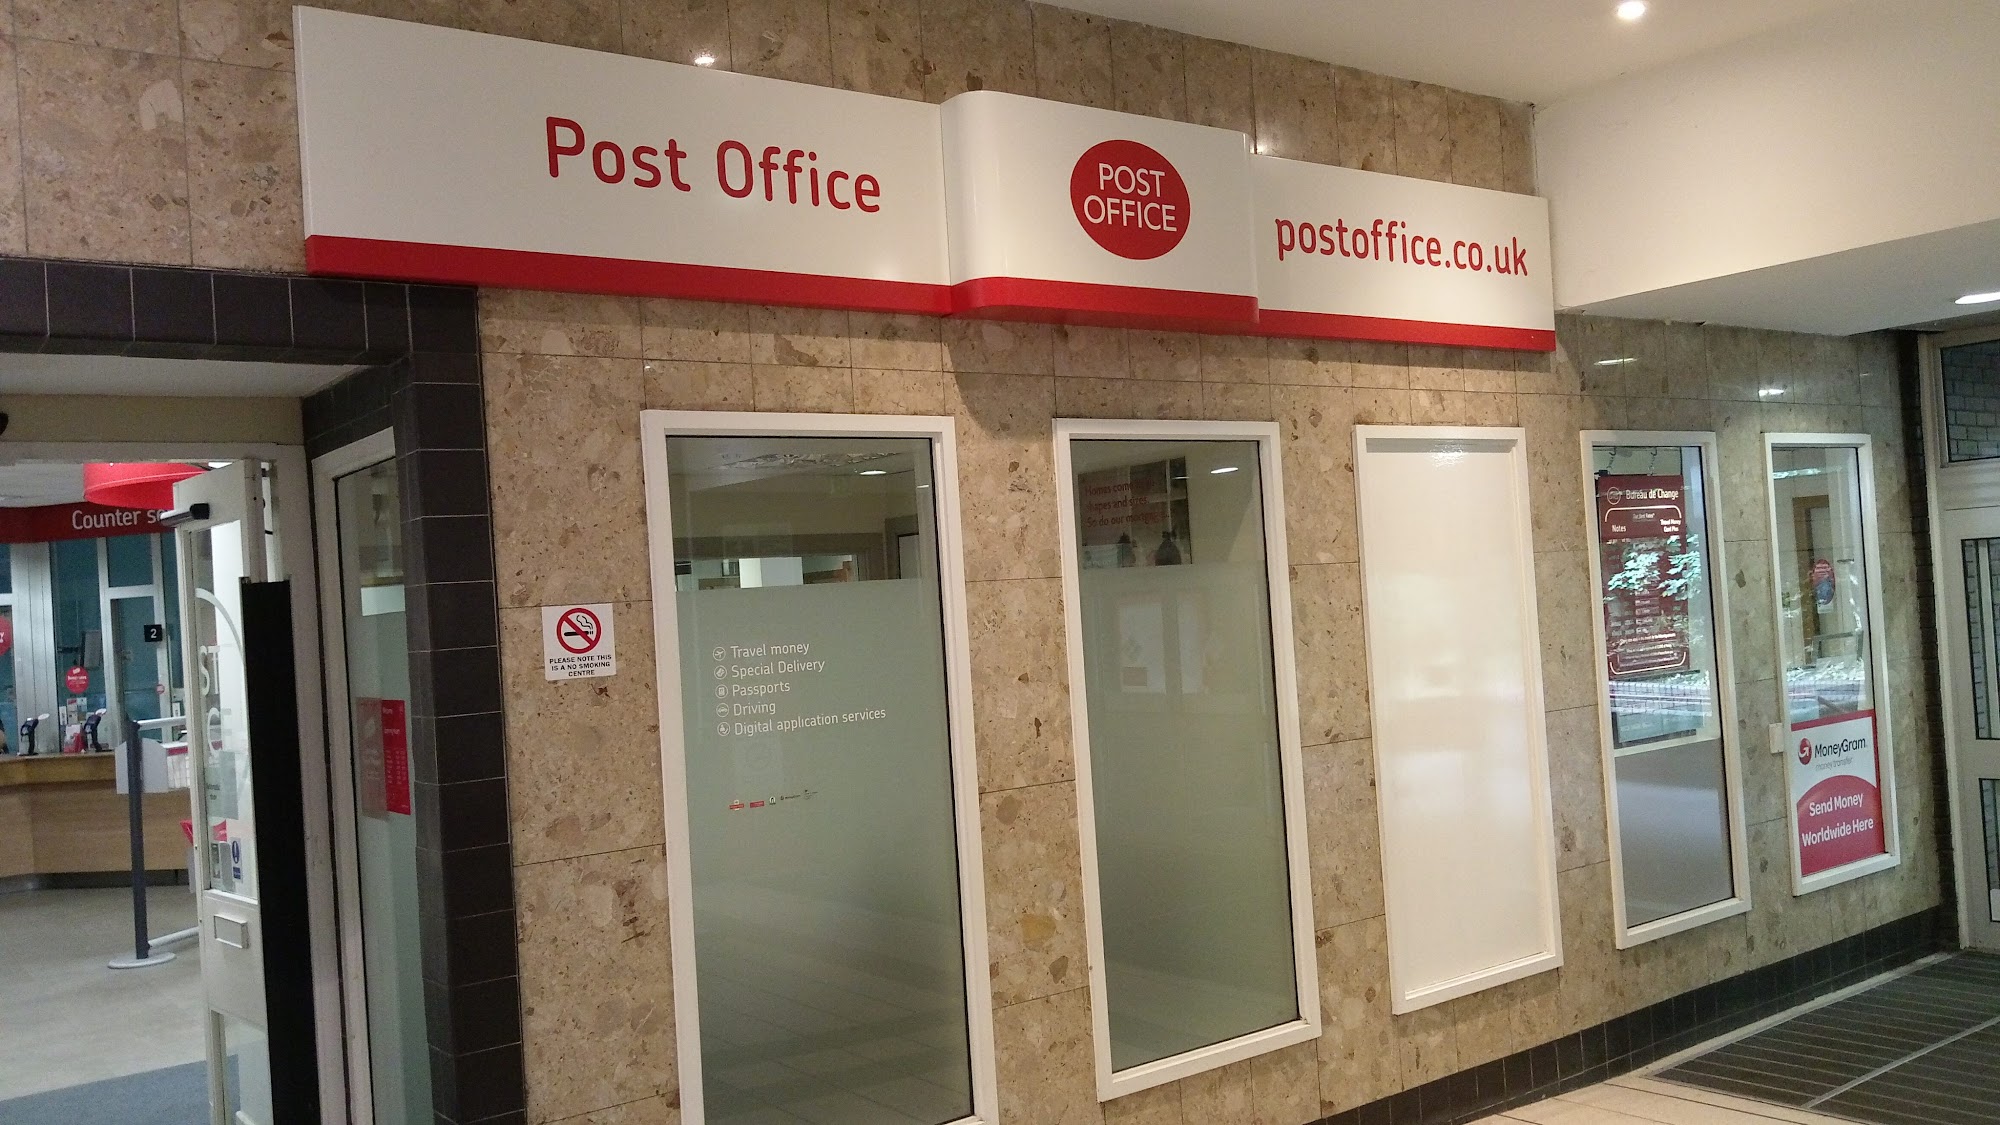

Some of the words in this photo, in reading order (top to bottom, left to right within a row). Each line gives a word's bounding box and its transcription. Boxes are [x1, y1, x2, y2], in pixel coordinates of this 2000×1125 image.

[545, 116, 691, 192] Post
[716, 140, 881, 213] Office
[1098, 162, 1166, 198] POST
[1083, 194, 1178, 232] OFFICE
[1275, 217, 1529, 277] postoffice.co.uk
[1112, 495, 1128, 508] and
[1625, 489, 1647, 500] Bureau
[1648, 488, 1657, 499] de
[1657, 488, 1680, 501] Change
[72, 509, 141, 530] Counter
[1611, 525, 1627, 533] Notes
[150, 628, 157, 639] 2
[549, 656, 576, 664] PLEASE
[730, 644, 767, 660] Travel
[770, 643, 810, 656] money
[568, 669, 596, 677] CENTRE
[579, 661, 611, 669] SMOKING
[731, 662, 774, 680] Special
[778, 659, 826, 674] Delivery
[732, 681, 791, 697] Passports
[733, 702, 776, 717] Driving
[734, 720, 773, 737] Digital
[776, 713, 839, 732] application
[842, 707, 887, 723] services
[1814, 738, 1867, 758] MoneyGram
[1808, 796, 1833, 817] Send
[1833, 793, 1864, 810] Money
[1801, 821, 1852, 848] Worldwide
[1852, 817, 1874, 834] Here
